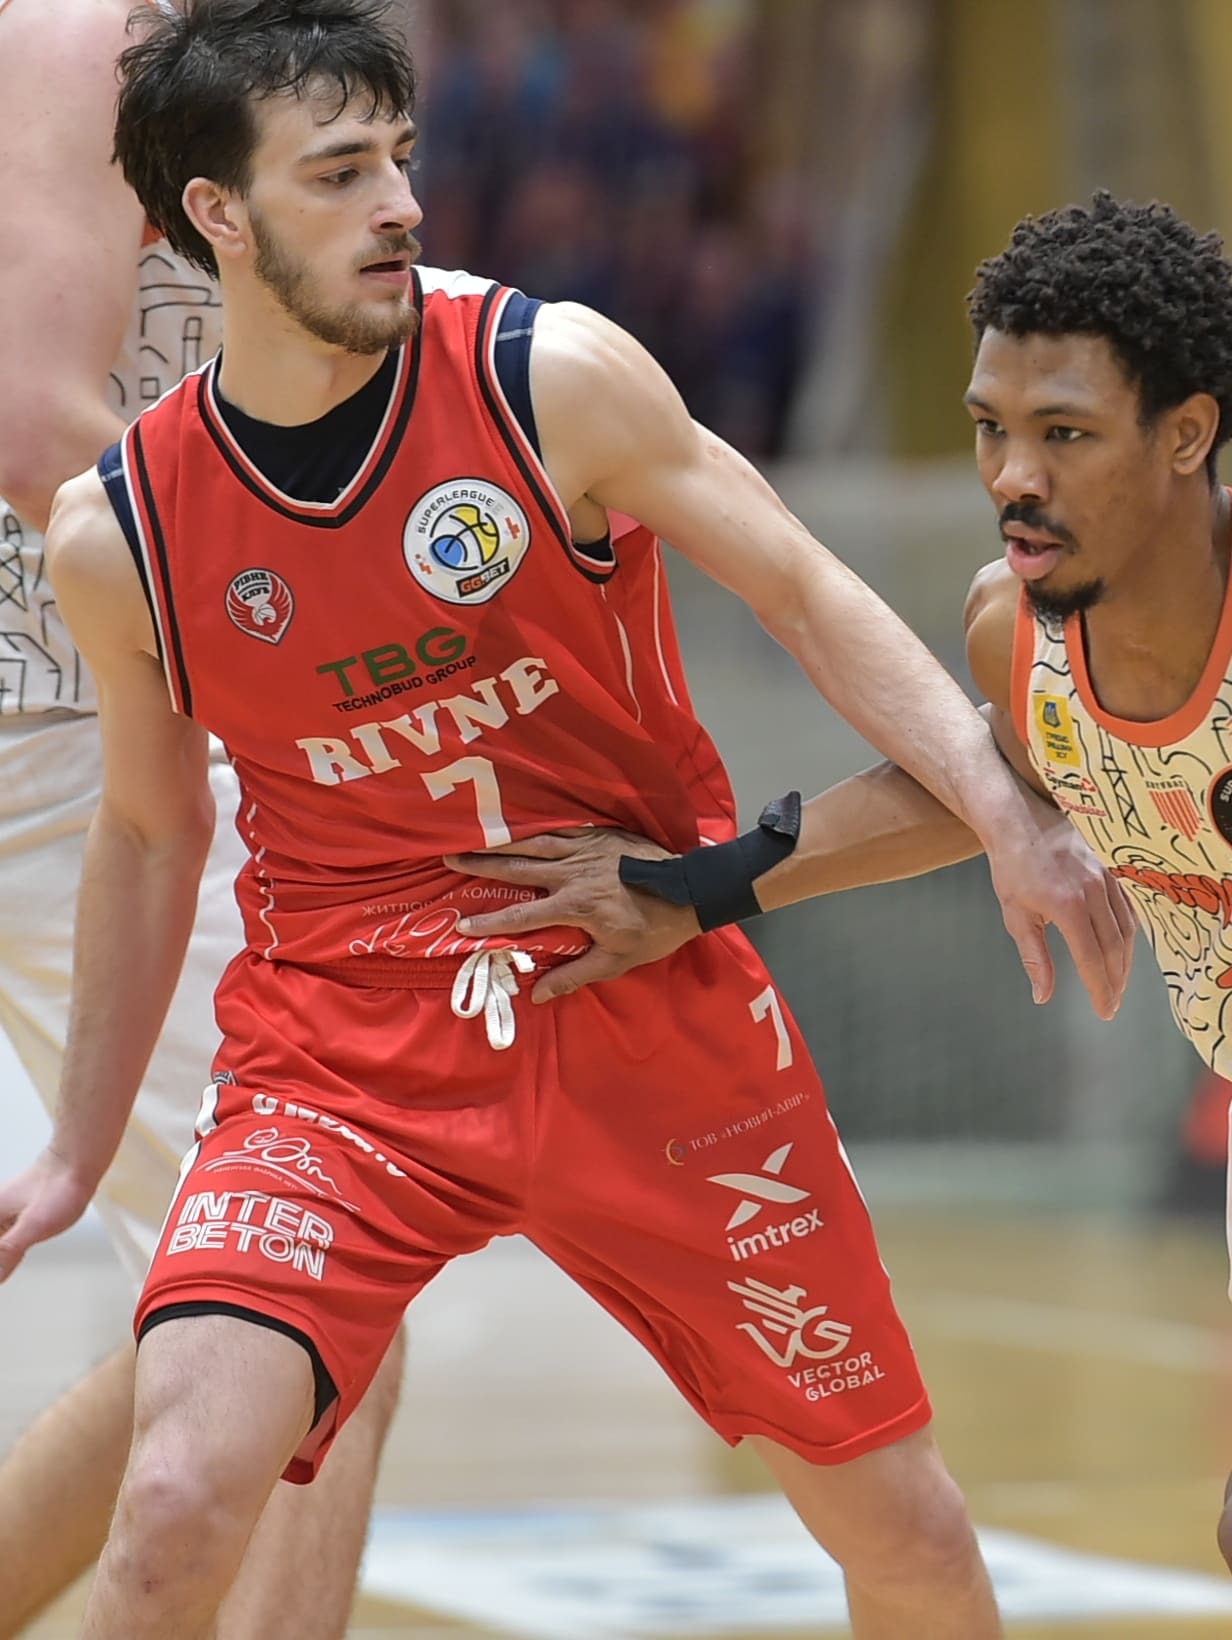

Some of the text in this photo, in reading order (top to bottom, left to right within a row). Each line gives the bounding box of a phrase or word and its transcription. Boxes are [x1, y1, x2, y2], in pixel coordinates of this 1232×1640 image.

[417, 489, 495, 534] SUPERLEAGUE
[316, 626, 467, 698] TBG
[332, 655, 477, 713] TECHNOBUD GROUP
[295, 657, 560, 786] RIVNE
[418, 755, 512, 849] 7
[748, 984, 793, 1072] 7
[177, 1190, 334, 1249] INTER
[727, 1208, 825, 1262] imtrex
[166, 1221, 326, 1280] BETON
[787, 1351, 873, 1388] VECTOR
[805, 1365, 886, 1401] GLOBAL
